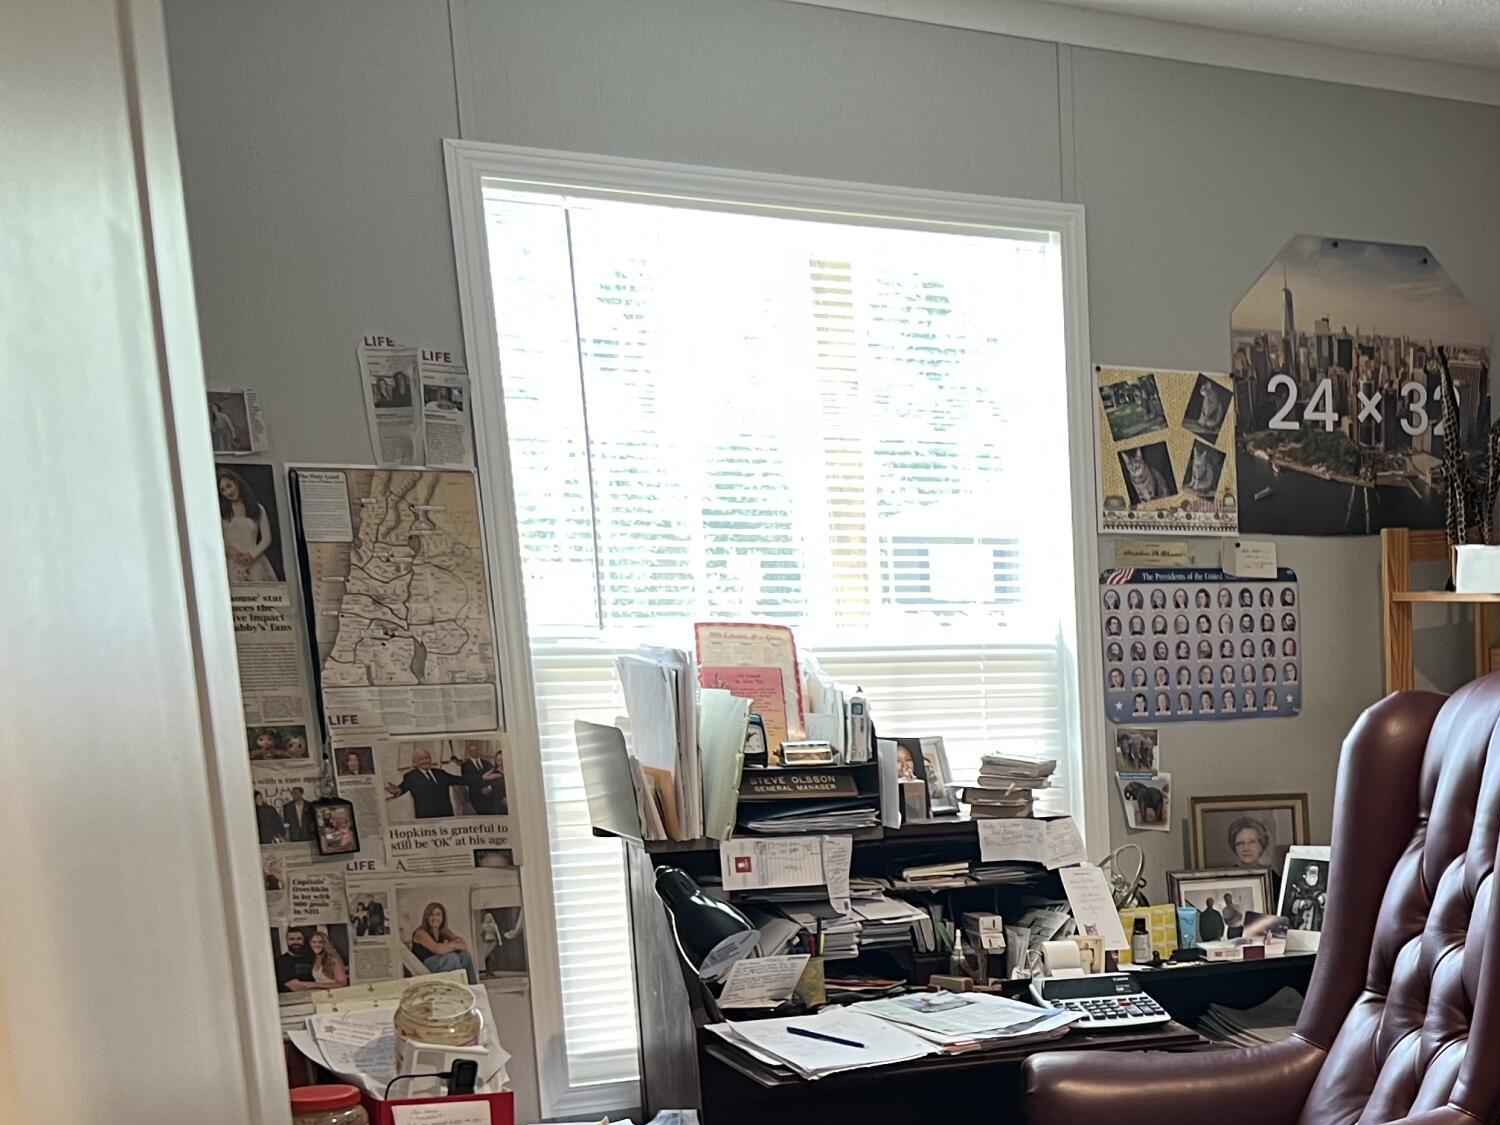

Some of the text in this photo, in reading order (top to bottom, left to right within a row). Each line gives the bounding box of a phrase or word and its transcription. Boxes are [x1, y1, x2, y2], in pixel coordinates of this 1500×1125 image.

[364, 336, 395, 347] LIFE
[422, 350, 452, 363] LIFE
[1267, 374, 1339, 433] 24
[250, 614, 284, 625] impact
[328, 714, 359, 726] LIFE
[750, 775, 836, 785] STEVE OLSSON
[754, 783, 837, 793] GENERAL MANAGER
[389, 824, 508, 840] Hopkins is grateful to
[391, 839, 413, 851] still
[415, 838, 429, 849] be
[455, 838, 467, 846] at
[469, 836, 486, 845] his
[488, 837, 508, 846] age
[346, 860, 376, 871] LIFE
